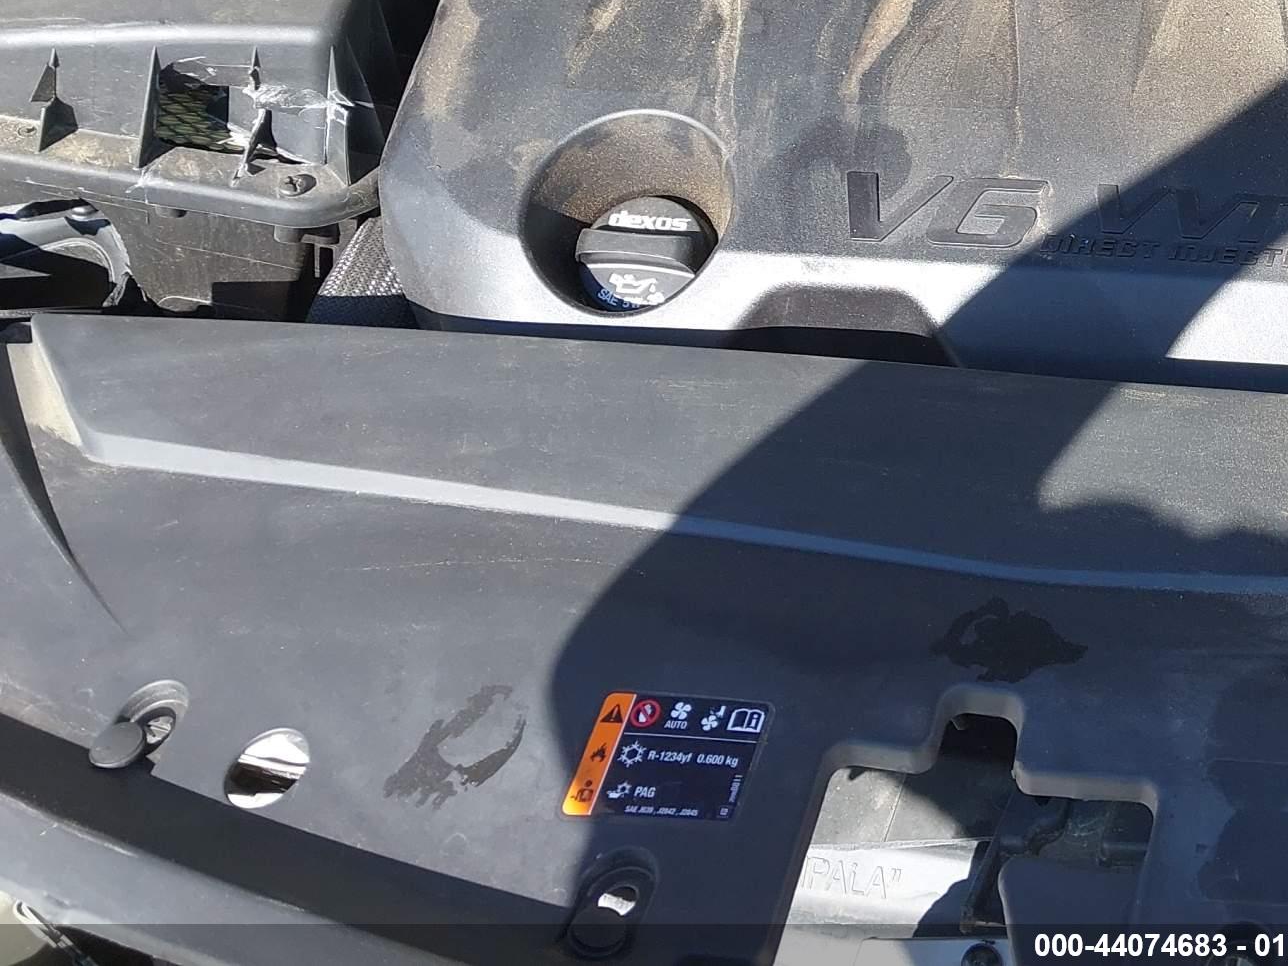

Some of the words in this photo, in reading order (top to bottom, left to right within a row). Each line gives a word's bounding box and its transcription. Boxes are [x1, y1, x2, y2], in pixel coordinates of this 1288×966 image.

[846, 170, 1050, 248] V6
[608, 210, 691, 231] dexos
[1039, 233, 1161, 261] DIRECT
[597, 288, 618, 306] SAE
[664, 720, 687, 730] AUTO
[647, 751, 692, 764] R-1234yf
[697, 753, 723, 765] 0.600
[724, 755, 738, 767] kg
[634, 786, 656, 798] PAG
[802, 856, 902, 899] PALA"
